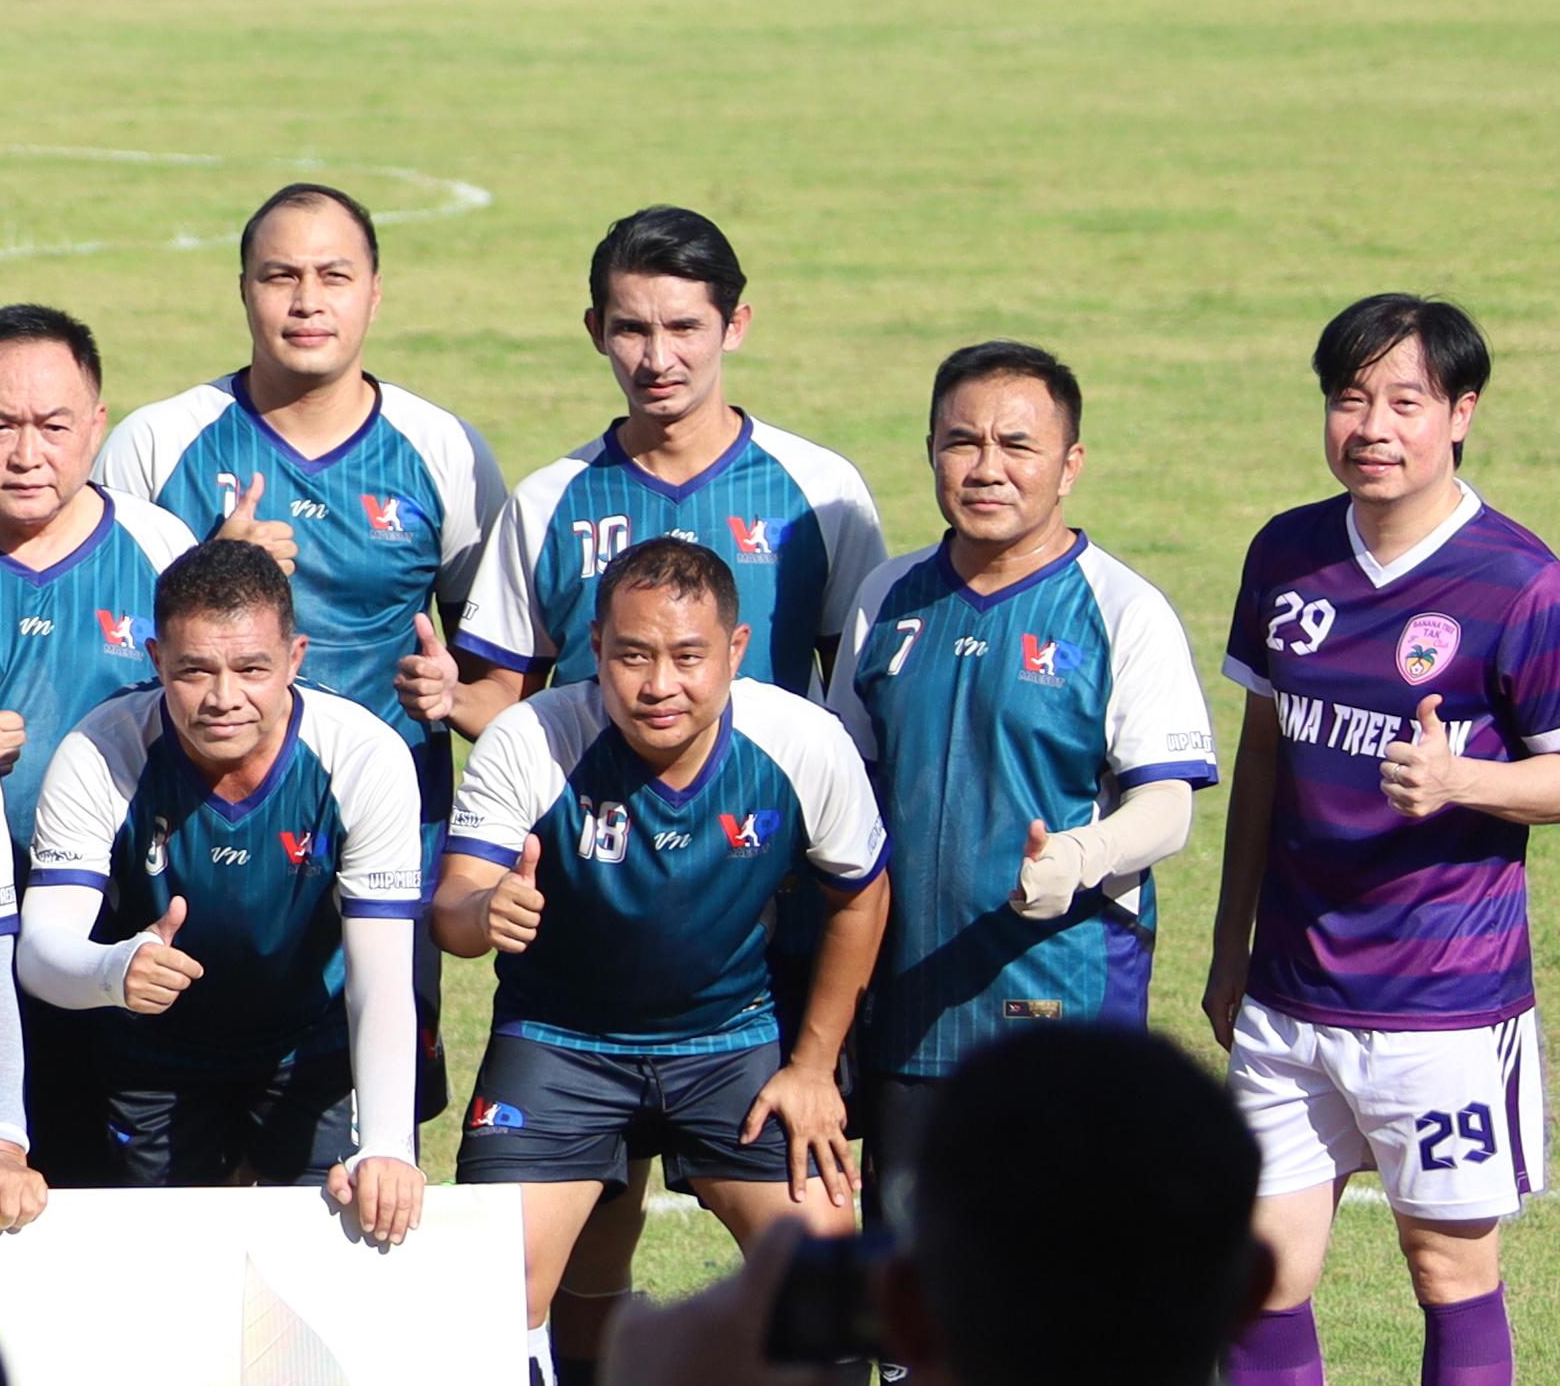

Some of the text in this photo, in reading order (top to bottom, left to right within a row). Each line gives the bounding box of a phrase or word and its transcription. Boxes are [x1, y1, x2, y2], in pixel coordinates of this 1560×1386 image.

[1266, 590, 1336, 656] 29
[1412, 619, 1457, 635] BANANA TREE
[1422, 628, 1442, 639] TAK
[887, 617, 924, 677] 7
[1166, 732, 1189, 753] VIP
[1327, 702, 1402, 759] TREE
[368, 872, 394, 890] VIP
[1416, 1101, 1499, 1172] 29
